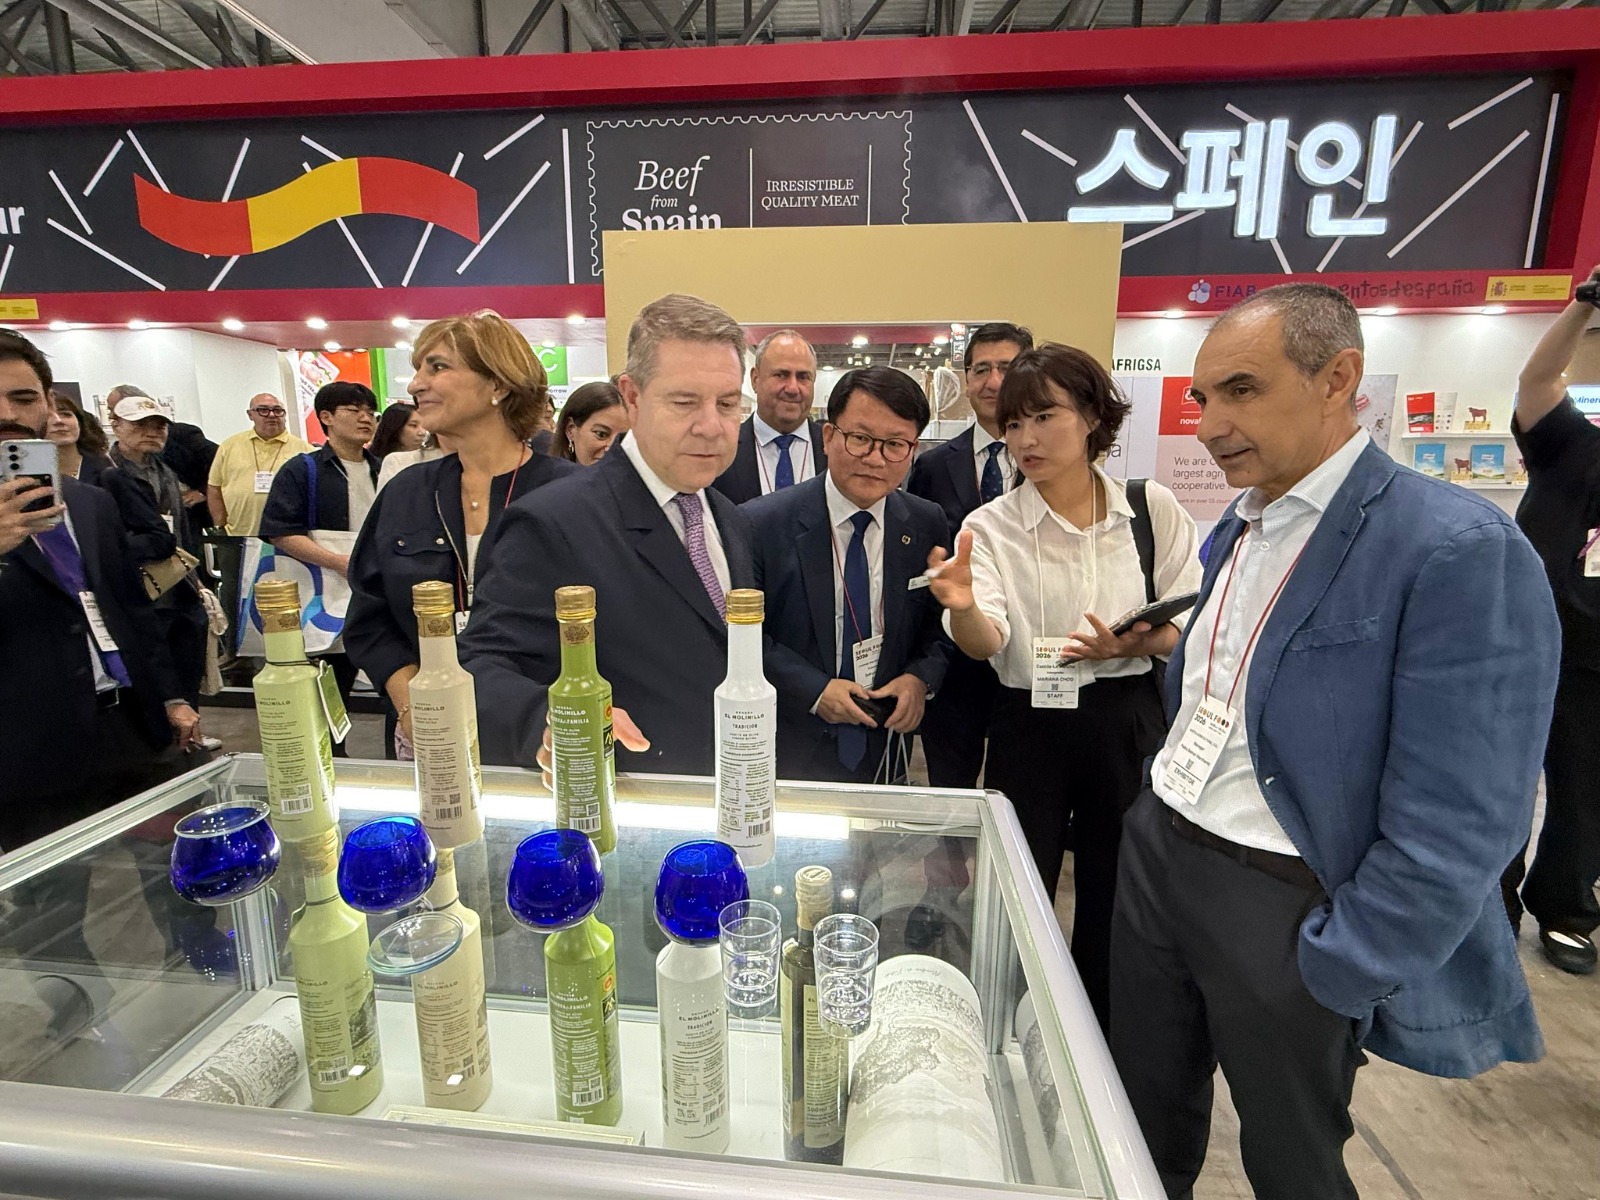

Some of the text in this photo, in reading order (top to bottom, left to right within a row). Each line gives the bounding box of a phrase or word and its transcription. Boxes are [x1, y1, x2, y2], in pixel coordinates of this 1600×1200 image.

[634, 155, 711, 197] Beef
[1066, 114, 1397, 240] 스페인
[766, 178, 854, 193] IRRESISTIBLE
[650, 194, 679, 210] from
[761, 195, 860, 209] QUALITY MEAT
[1174, 456, 1190, 466] We
[1192, 458, 1207, 466] are
[1173, 469, 1204, 480] largest
[1172, 481, 1226, 491] cooperative
[1198, 706, 1230, 728] SEOUL FOOD
[1174, 767, 1196, 786] EXHIBITOR
